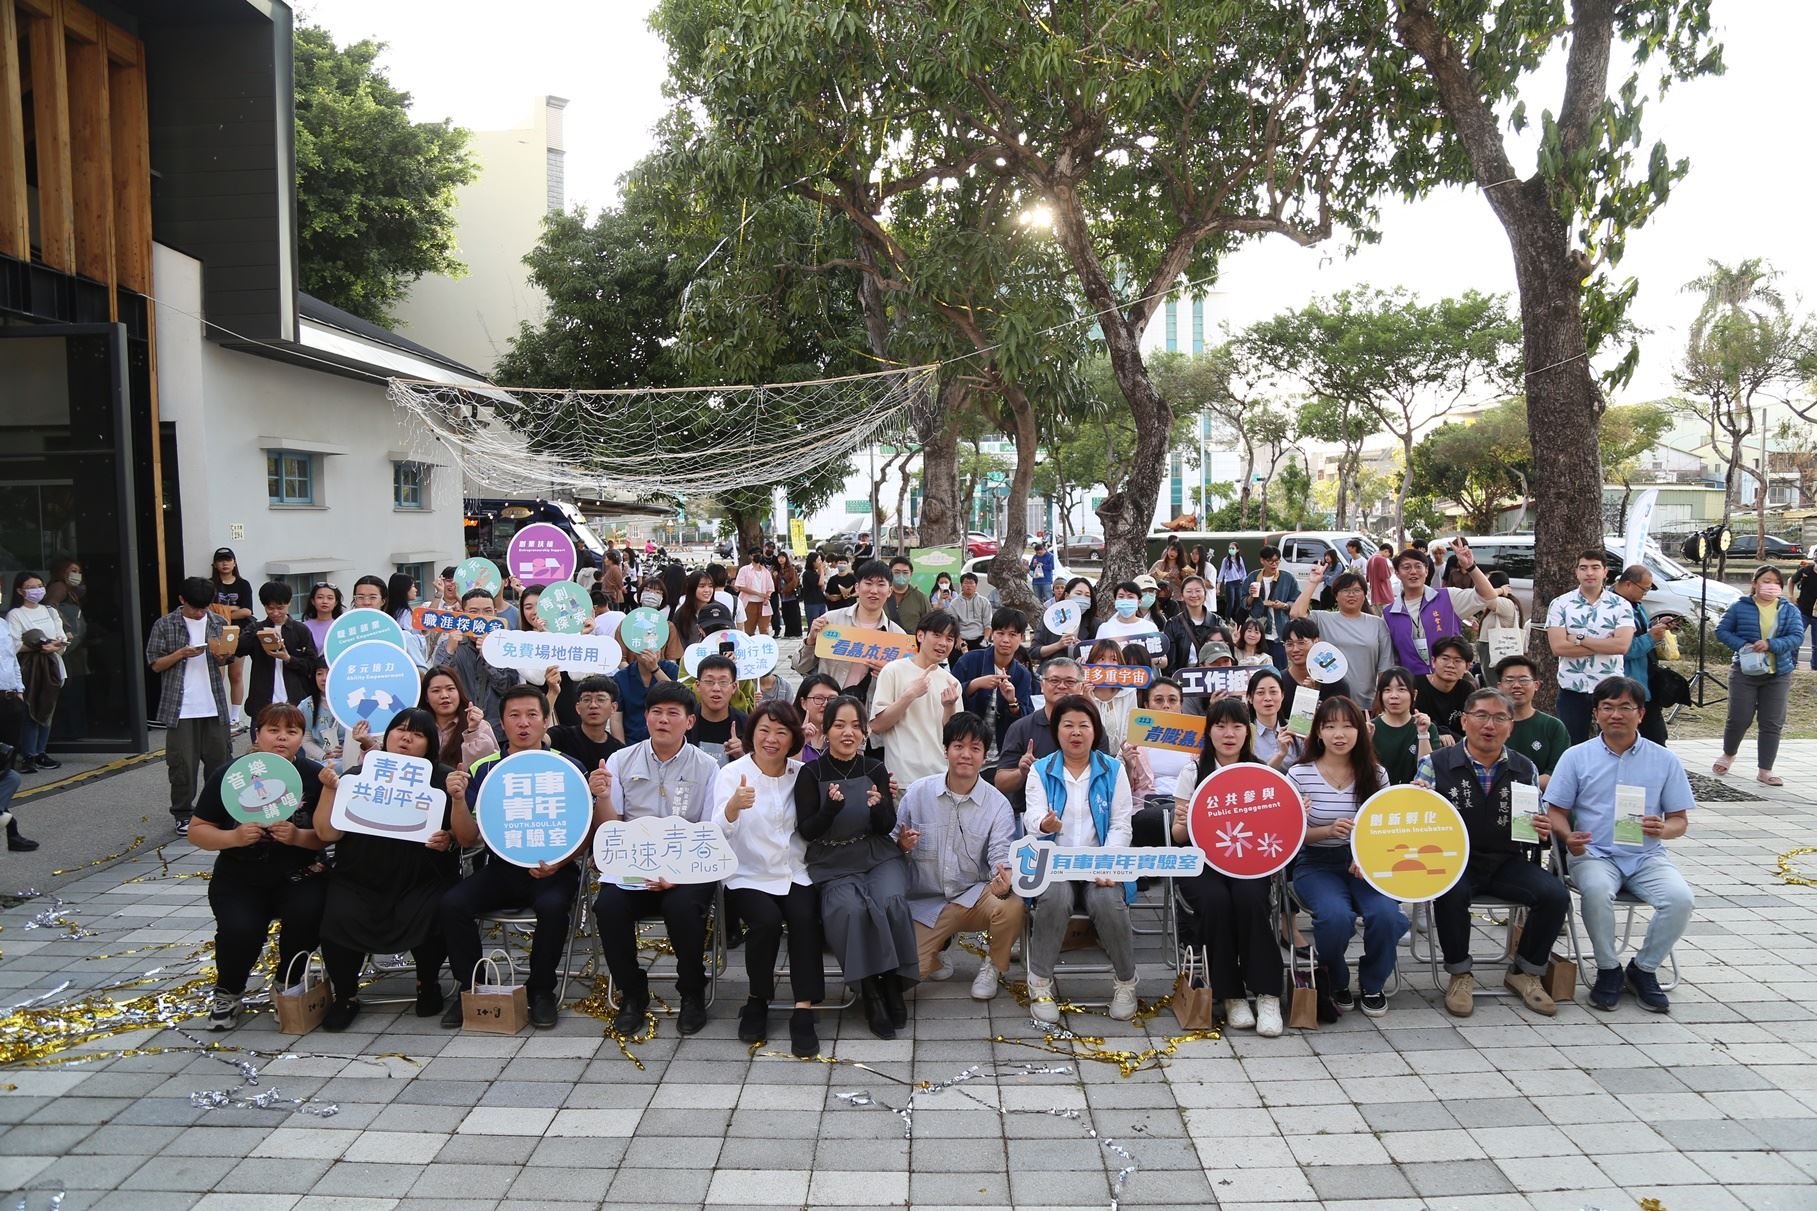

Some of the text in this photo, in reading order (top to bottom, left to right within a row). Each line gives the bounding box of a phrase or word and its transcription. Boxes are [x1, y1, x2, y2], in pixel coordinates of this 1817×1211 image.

[502, 641, 599, 663] 免費場地借用
[346, 674, 366, 682] Ability
[347, 662, 395, 674] 多元培力
[226, 759, 269, 790] 音樂
[373, 757, 425, 788] 青年
[502, 771, 565, 797] 有事
[352, 781, 434, 811] 共創平台
[1206, 787, 1275, 809] 公共參與
[503, 796, 566, 821] 青年
[1207, 801, 1281, 817] Public Engagement
[1370, 810, 1437, 827] 創新孵化
[504, 827, 567, 849] 實驗室
[1369, 825, 1456, 835] Innovation Incubators
[600, 823, 720, 872] 嘉速青春
[691, 861, 718, 873] Plus
[1052, 853, 1198, 870] 有事青年實驗室
